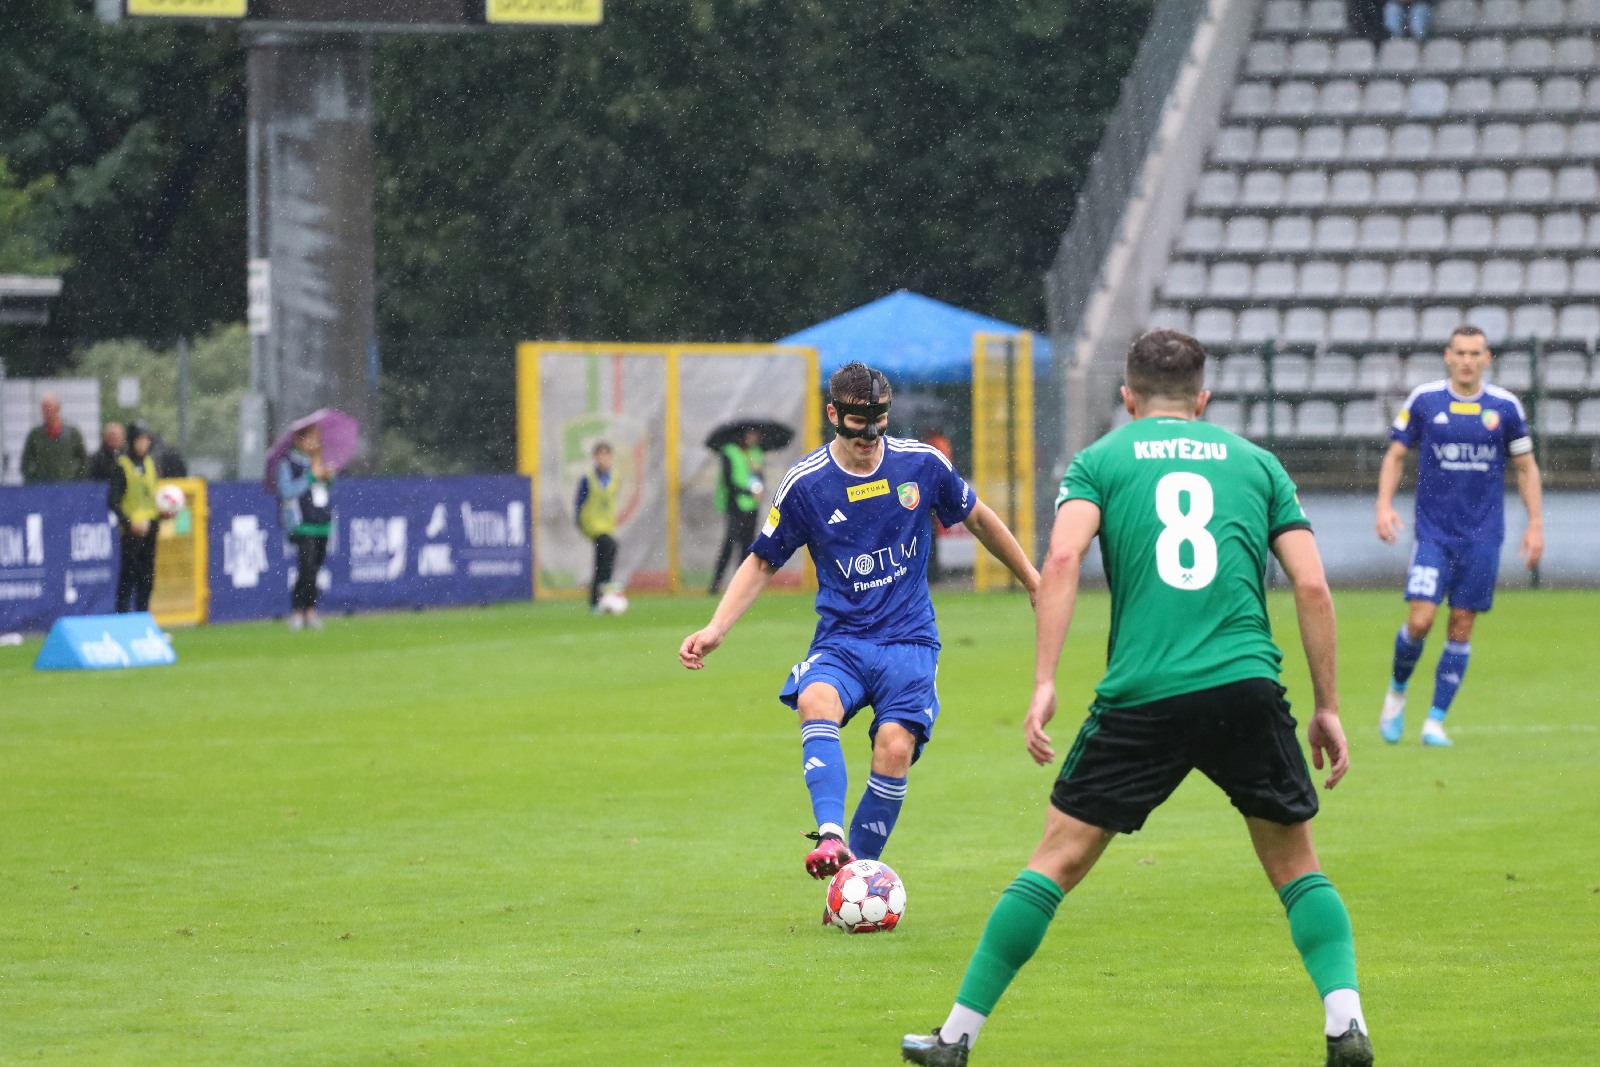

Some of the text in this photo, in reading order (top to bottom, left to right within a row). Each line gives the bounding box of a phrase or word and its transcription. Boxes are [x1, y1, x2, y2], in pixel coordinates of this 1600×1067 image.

[1134, 438, 1227, 460] KRYEZIU
[1431, 442, 1497, 462] VOTUM
[850, 484, 885, 496] FORTUNA
[1156, 471, 1218, 590] 8
[836, 536, 917, 578] VOTUM
[853, 575, 893, 592] Finance
[1407, 565, 1439, 597] 25
